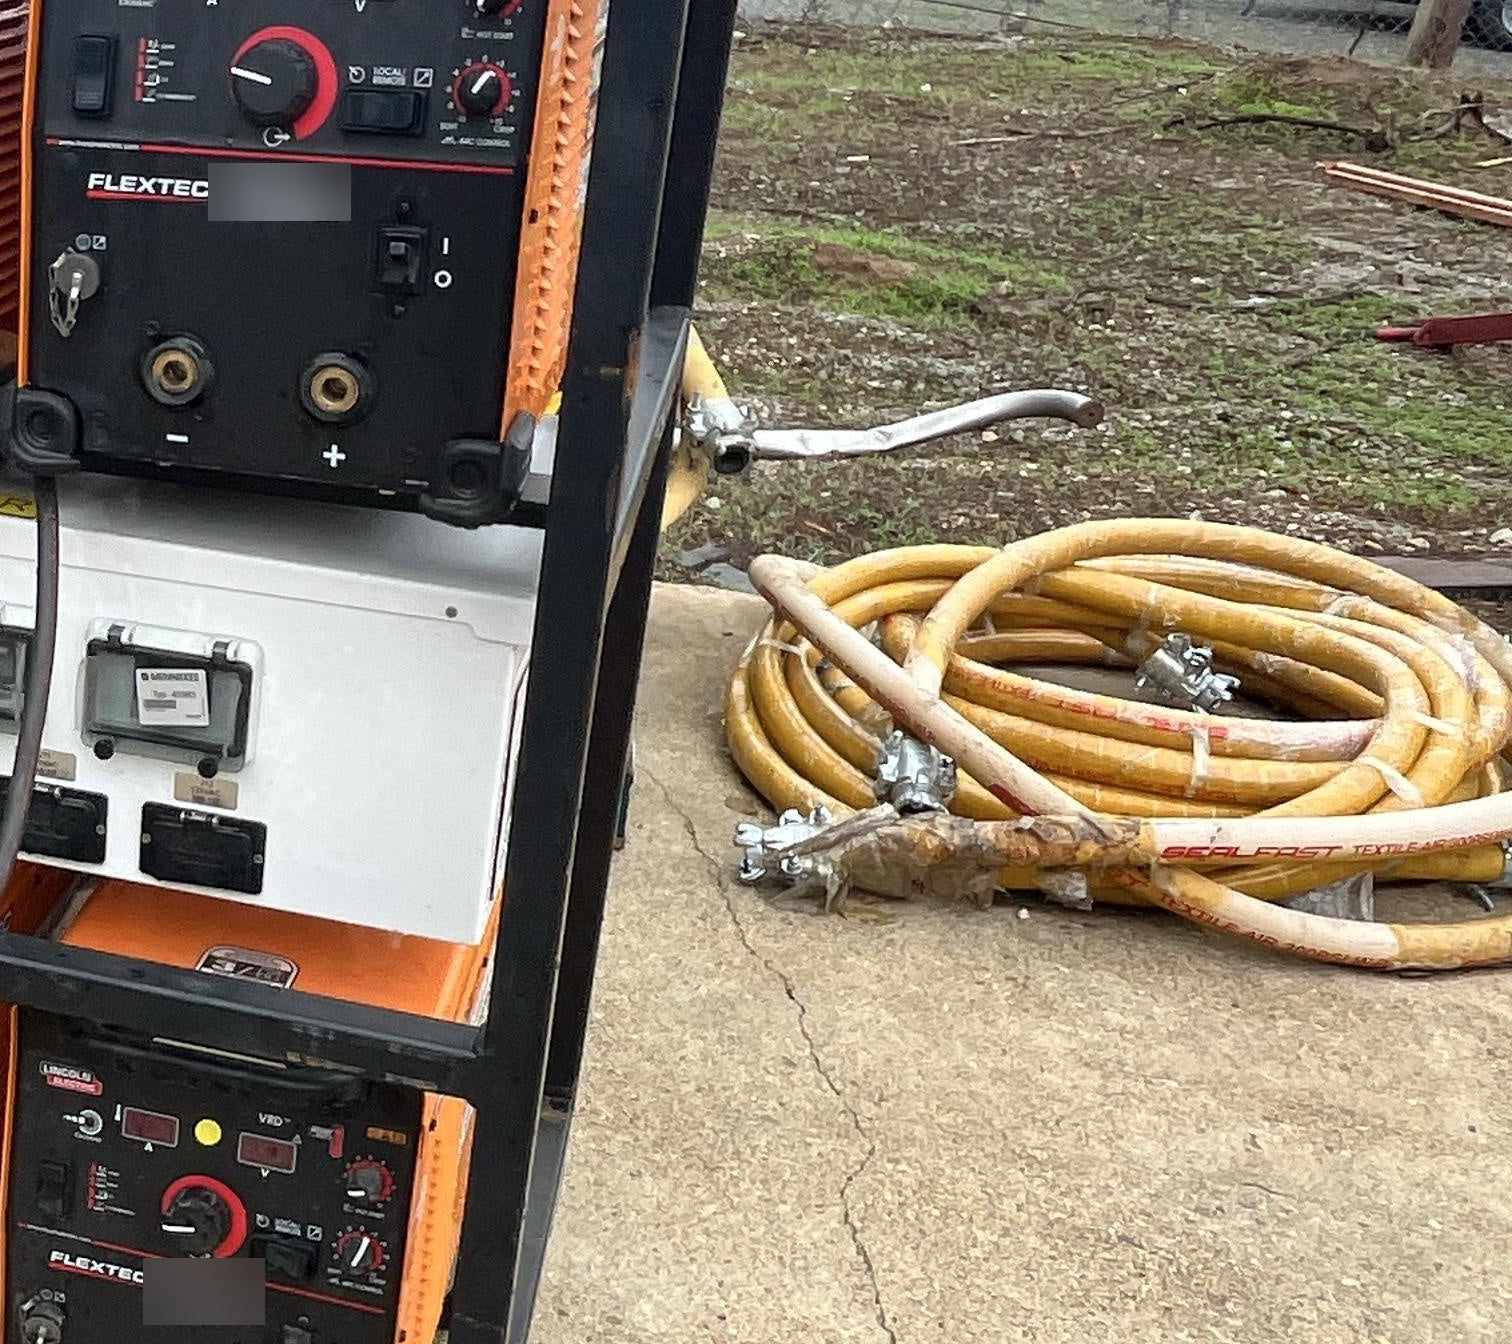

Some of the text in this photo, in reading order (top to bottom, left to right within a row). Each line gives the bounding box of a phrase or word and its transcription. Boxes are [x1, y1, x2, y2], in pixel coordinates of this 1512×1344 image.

[88, 173, 208, 198] FLEXTEC
[1161, 845, 1343, 859] SEALFAST
[1352, 842, 1418, 856] TEXTILE
[1247, 930, 1279, 947] AIR
[49, 1250, 143, 1284] FLEXTEC
